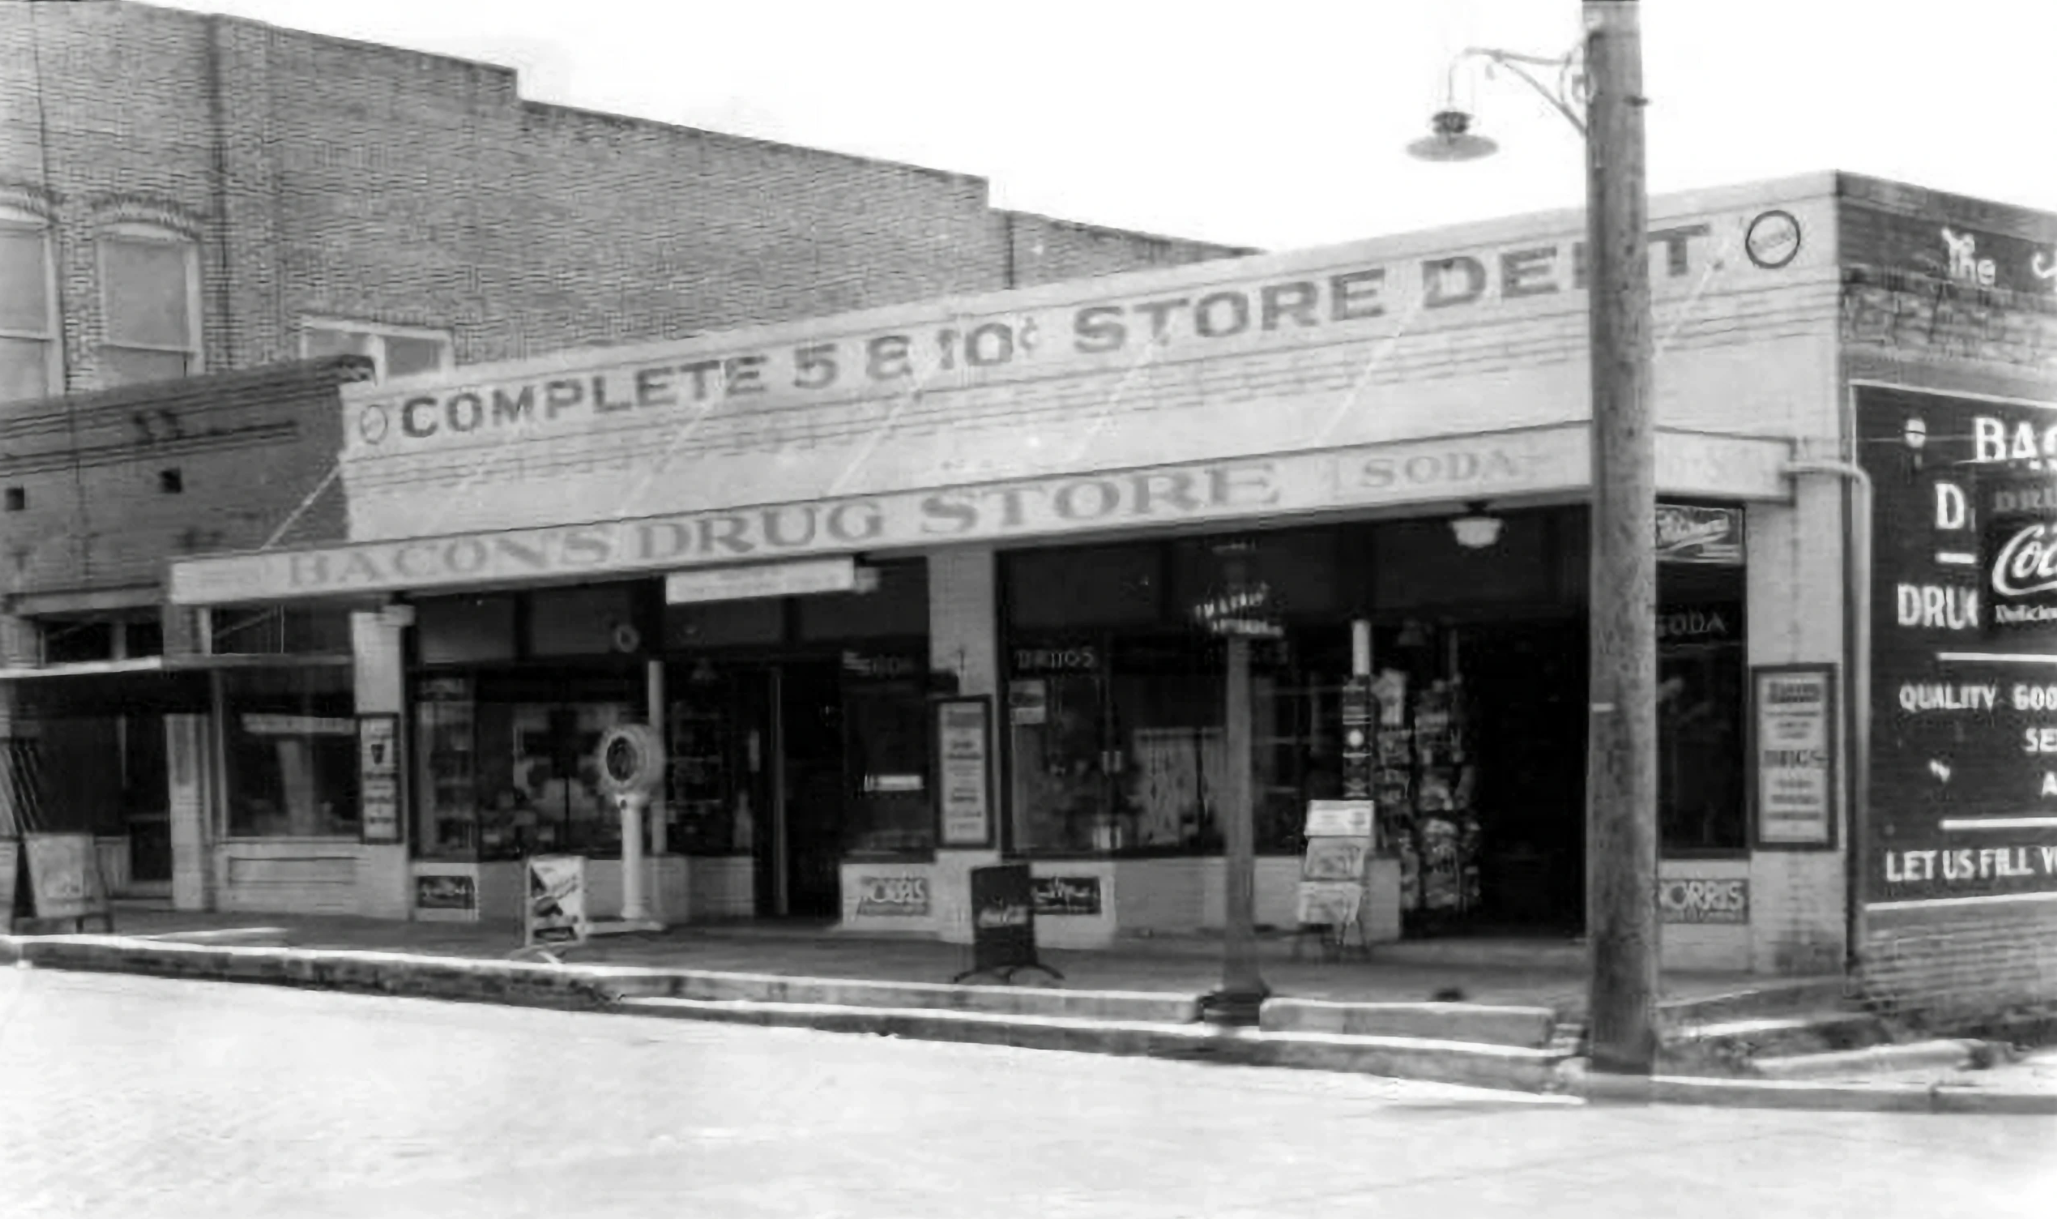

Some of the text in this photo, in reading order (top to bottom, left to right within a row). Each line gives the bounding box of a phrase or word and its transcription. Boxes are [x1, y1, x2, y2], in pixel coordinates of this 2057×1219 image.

[402, 355, 769, 438] COMPLETE
[793, 343, 840, 390] 5
[865, 335, 912, 382] &
[1073, 269, 1387, 354] STORE
[638, 502, 883, 559] DRUG
[918, 461, 1279, 535] STORE
[1360, 448, 1518, 488] SODA
[1934, 482, 1976, 532] D
[1898, 684, 1998, 713] QUALITY
[1885, 850, 1938, 883] LET
[1942, 848, 1976, 881] US
[1979, 845, 2035, 879] FILL
